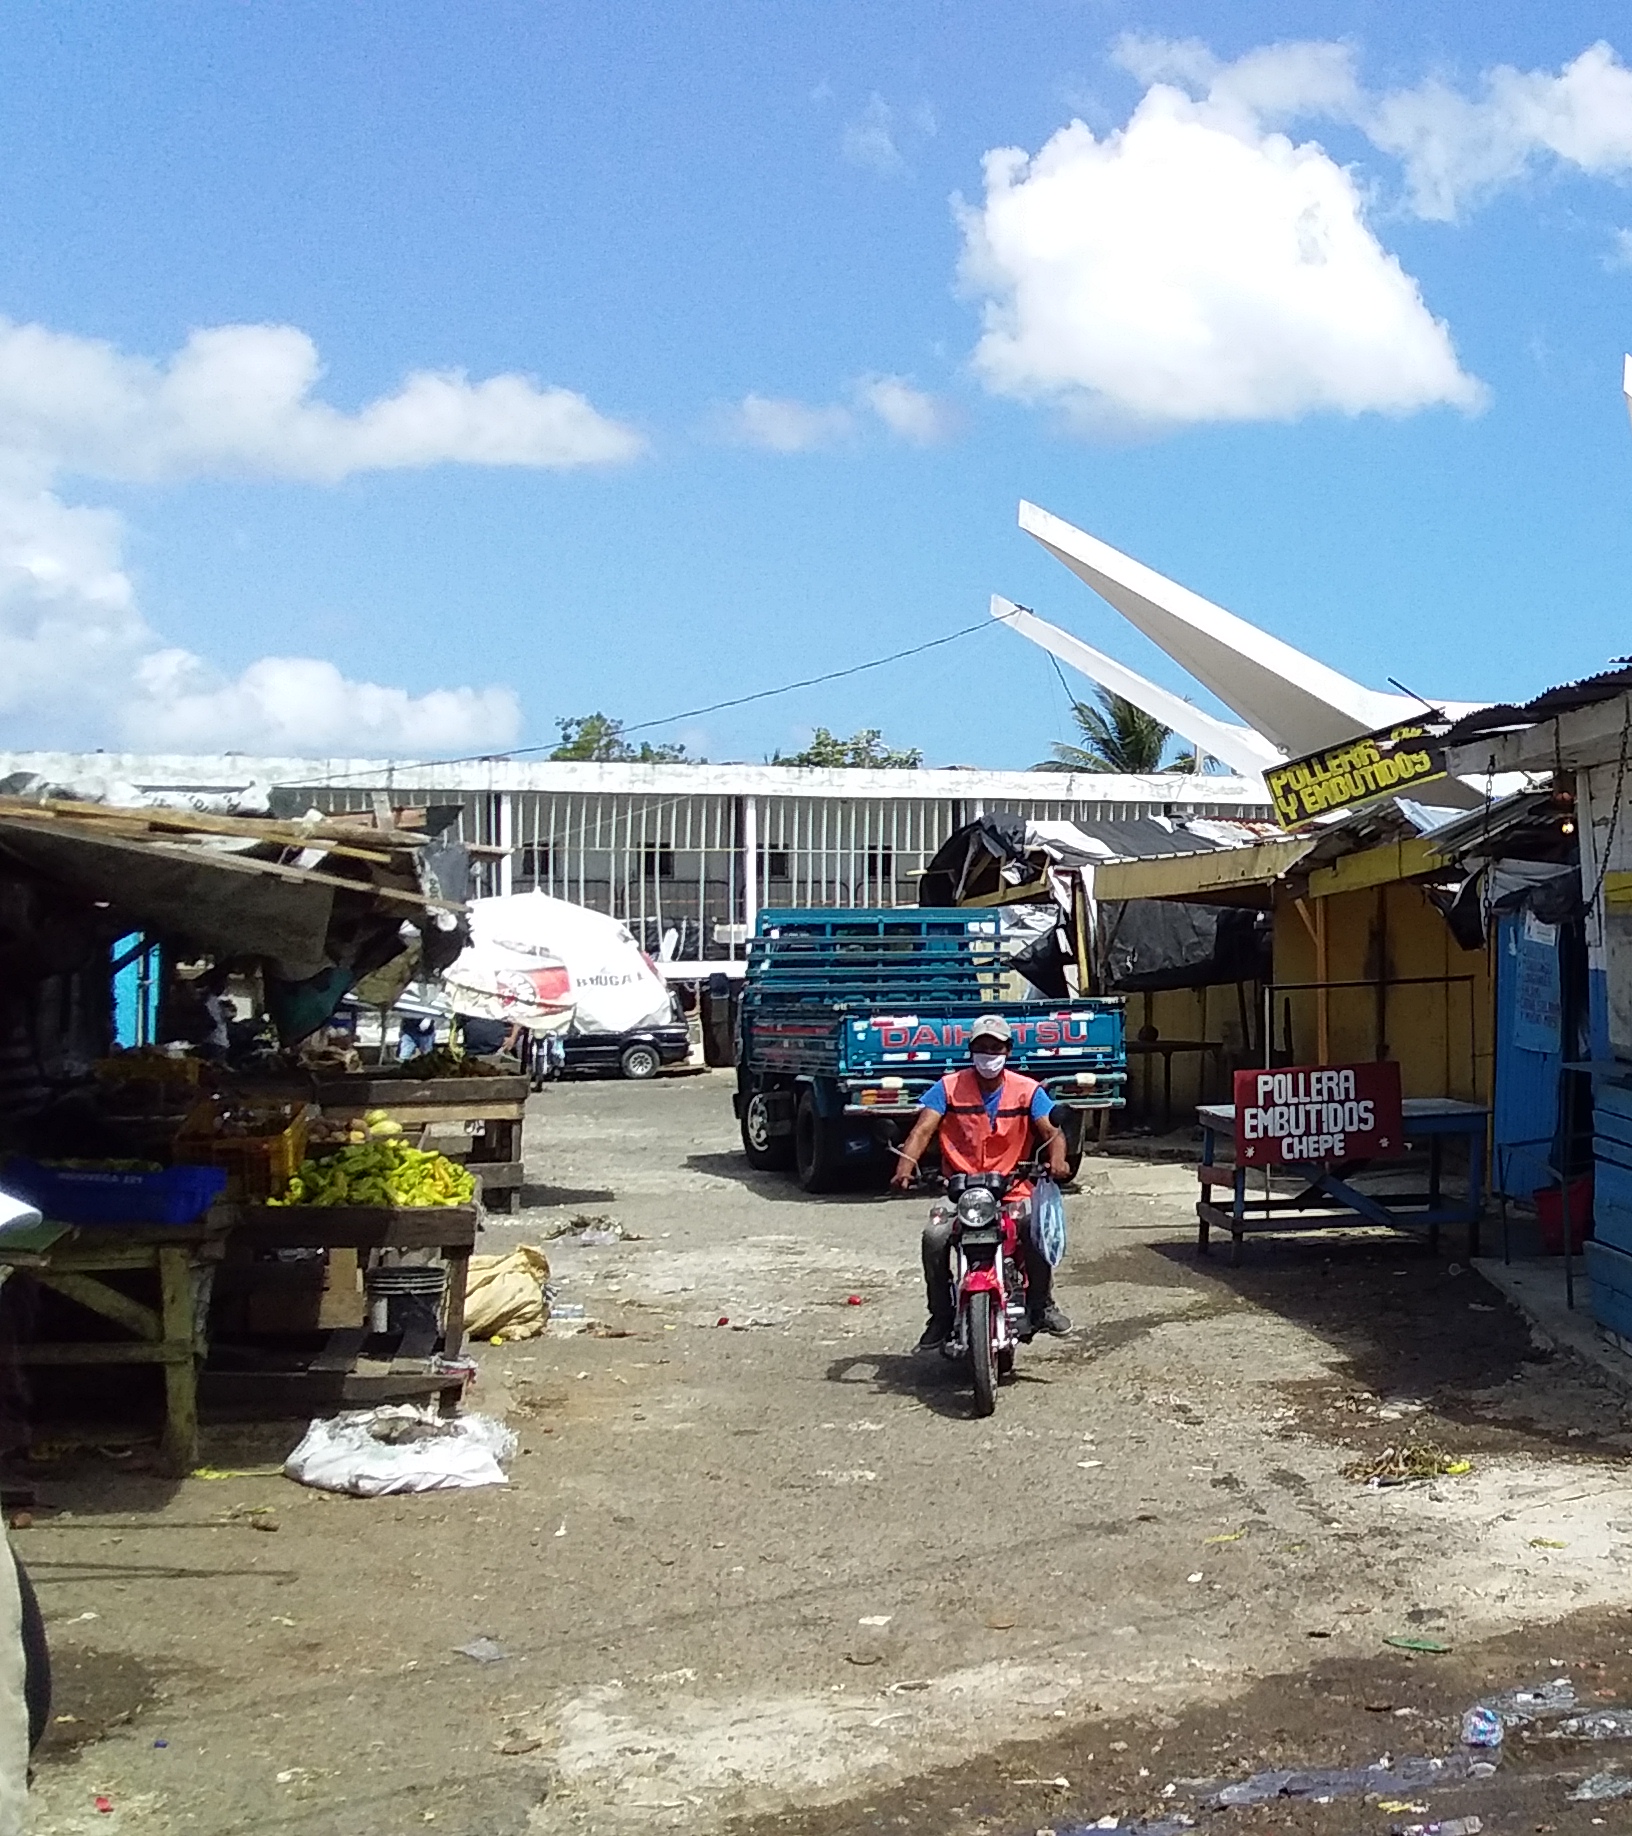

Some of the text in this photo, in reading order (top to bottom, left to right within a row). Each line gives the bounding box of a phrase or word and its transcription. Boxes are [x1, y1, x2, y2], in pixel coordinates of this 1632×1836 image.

[1268, 738, 1380, 798] POLLERA
[1277, 749, 1432, 820] Y EMBUTIDOS
[880, 1020, 1089, 1048] DAIHTSU
[1257, 1069, 1356, 1107] POLLERA
[1244, 1100, 1375, 1140] EMBUTIDOS
[1281, 1132, 1346, 1160] CHEPE
